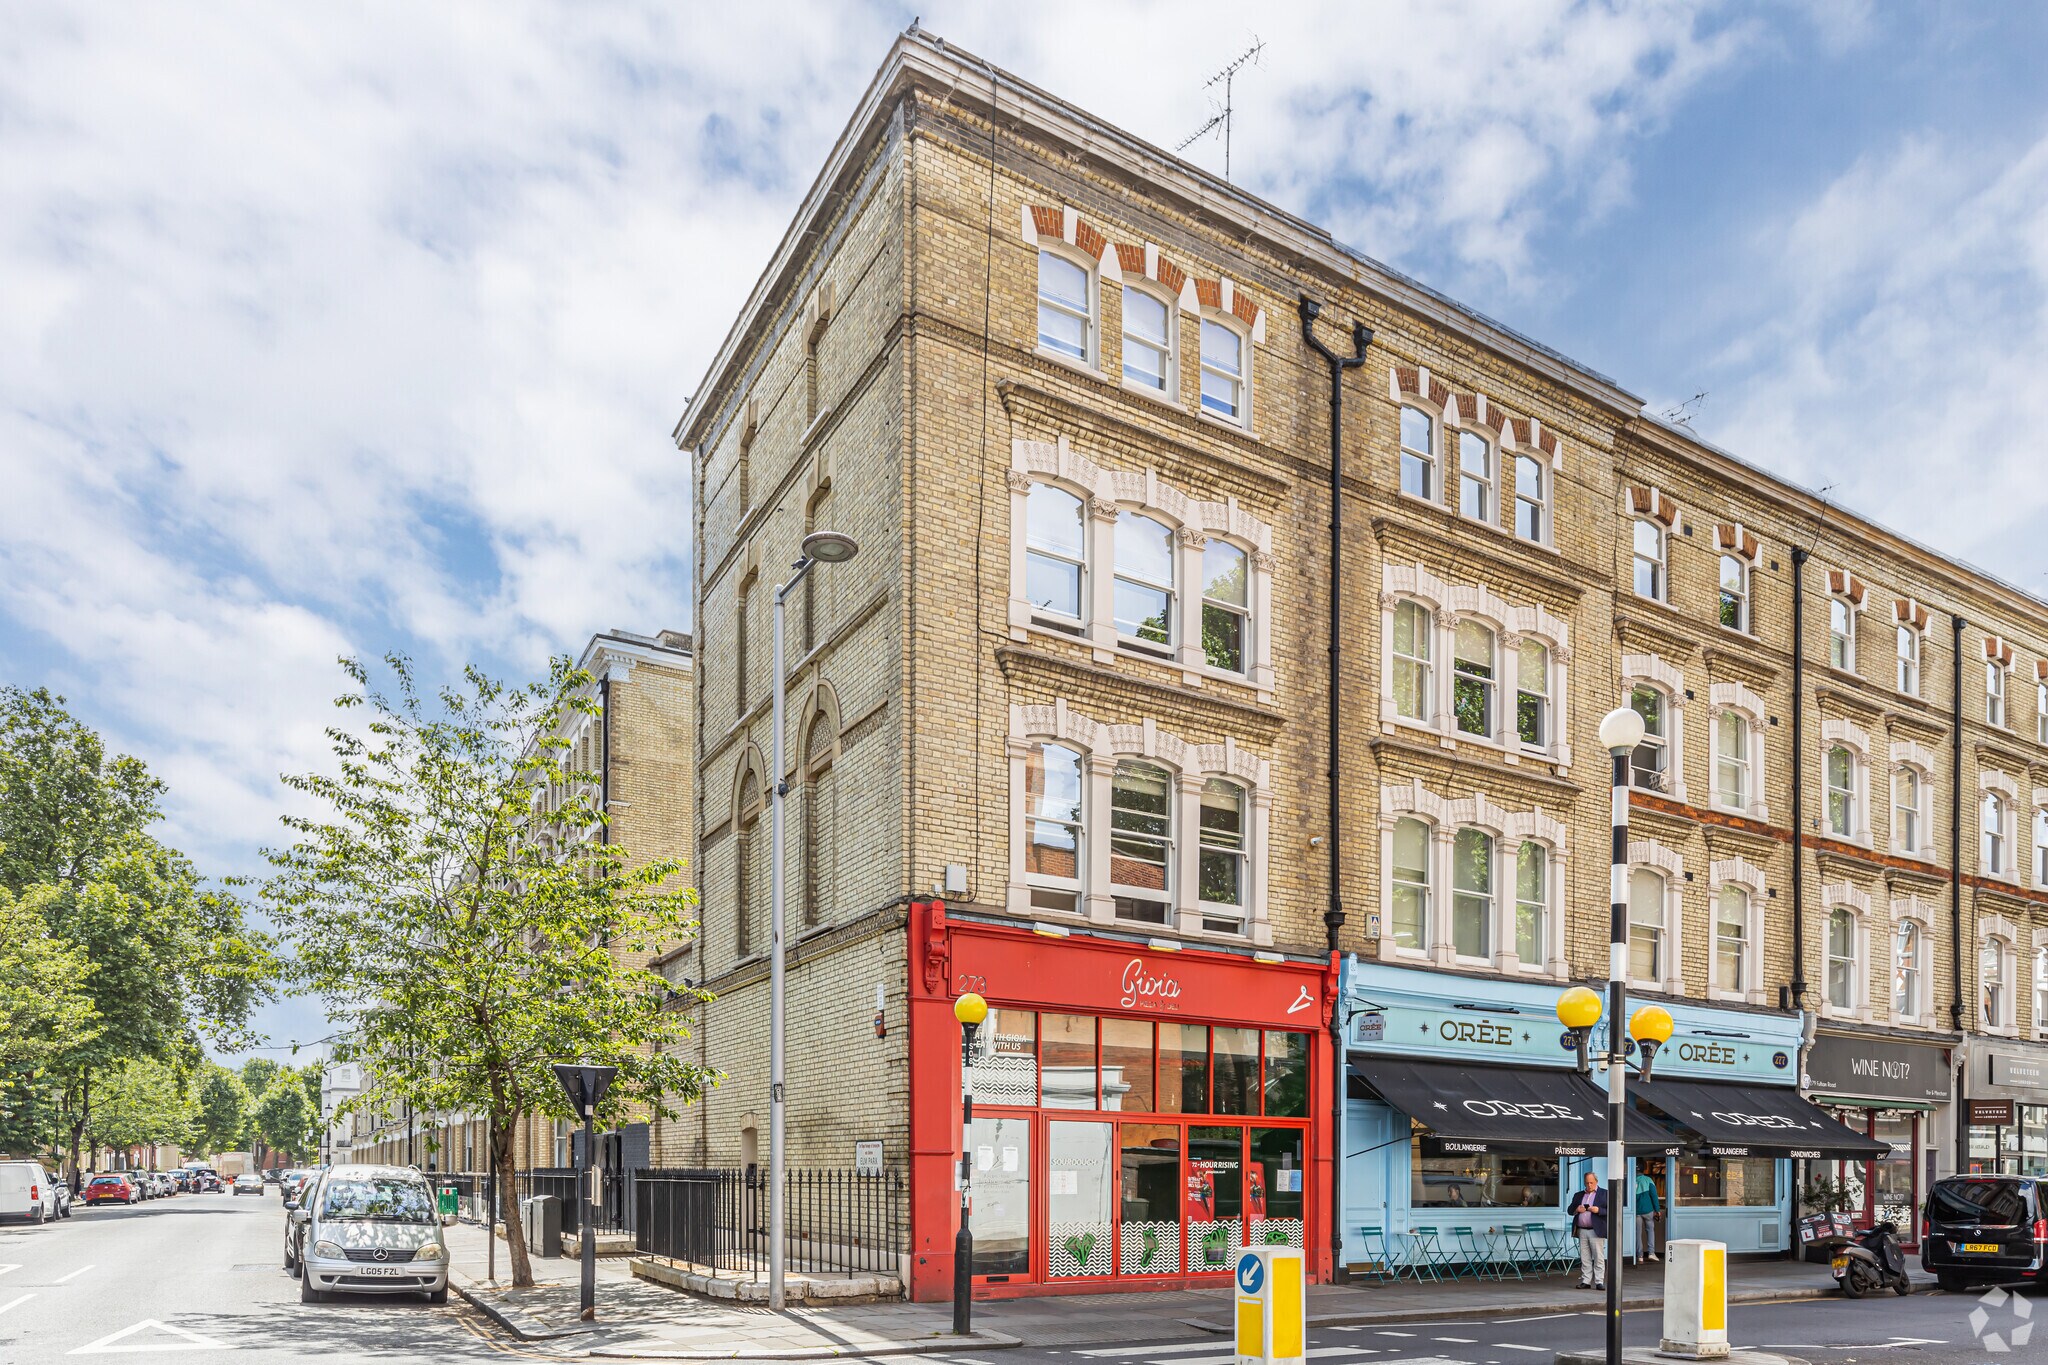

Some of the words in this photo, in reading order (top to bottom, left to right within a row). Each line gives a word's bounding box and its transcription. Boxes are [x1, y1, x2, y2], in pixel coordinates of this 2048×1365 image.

[958, 974, 987, 994] 273
[1121, 958, 1182, 1008] Gioia
[1011, 1042, 1021, 1050] US
[1774, 1055, 1786, 1066] 277
[1851, 1058, 1879, 1078] WINE
[1882, 1060, 1910, 1080] NOT?
[1445, 1143, 1487, 1152] BOULANGERIE
[1665, 1147, 1680, 1156] CAFÉ
[1712, 1147, 1748, 1156] BOULANGERIE
[1790, 1150, 1821, 1159] SANDWICHES
[1218, 1161, 1239, 1169] RISING
[383, 1267, 399, 1276] FZL
